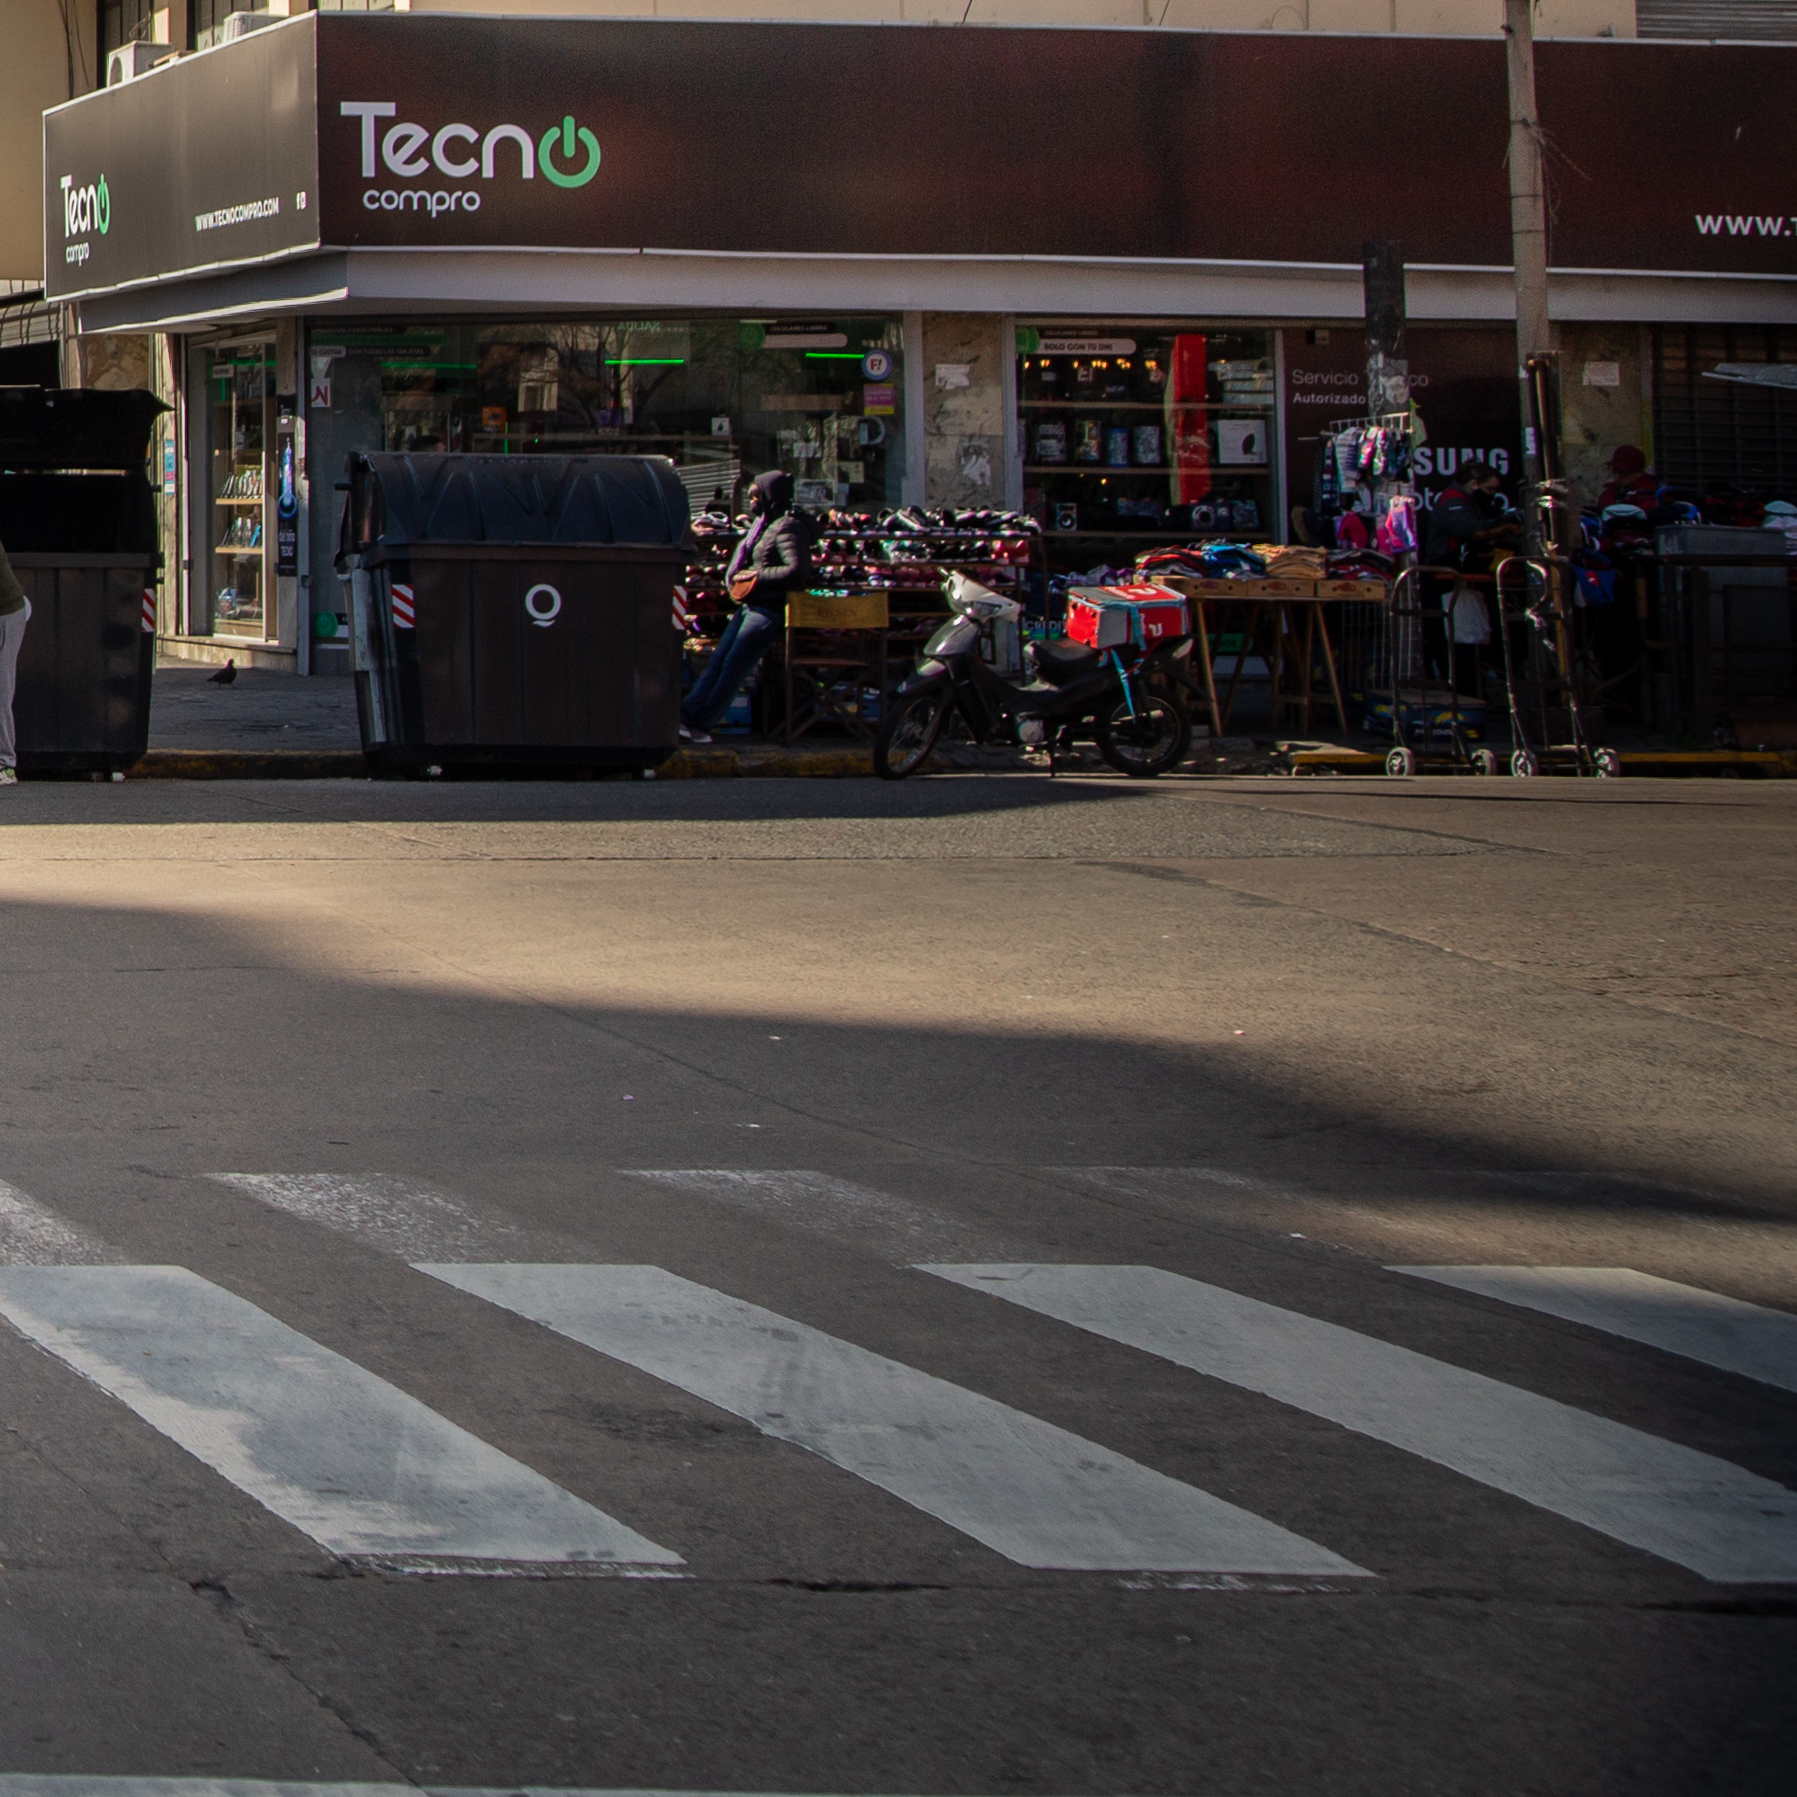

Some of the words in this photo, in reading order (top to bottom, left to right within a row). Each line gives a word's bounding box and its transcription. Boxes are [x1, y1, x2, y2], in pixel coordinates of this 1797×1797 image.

[194, 197, 280, 232] WWW.TECNOCOMPRO.COM
[362, 189, 481, 218] compro
[65, 242, 90, 266] compro
[1044, 342, 1066, 352] SOLO
[1292, 369, 1359, 385] Servicio
[1292, 391, 1366, 405] Autorizado
[1412, 446, 1510, 476] SUNG
